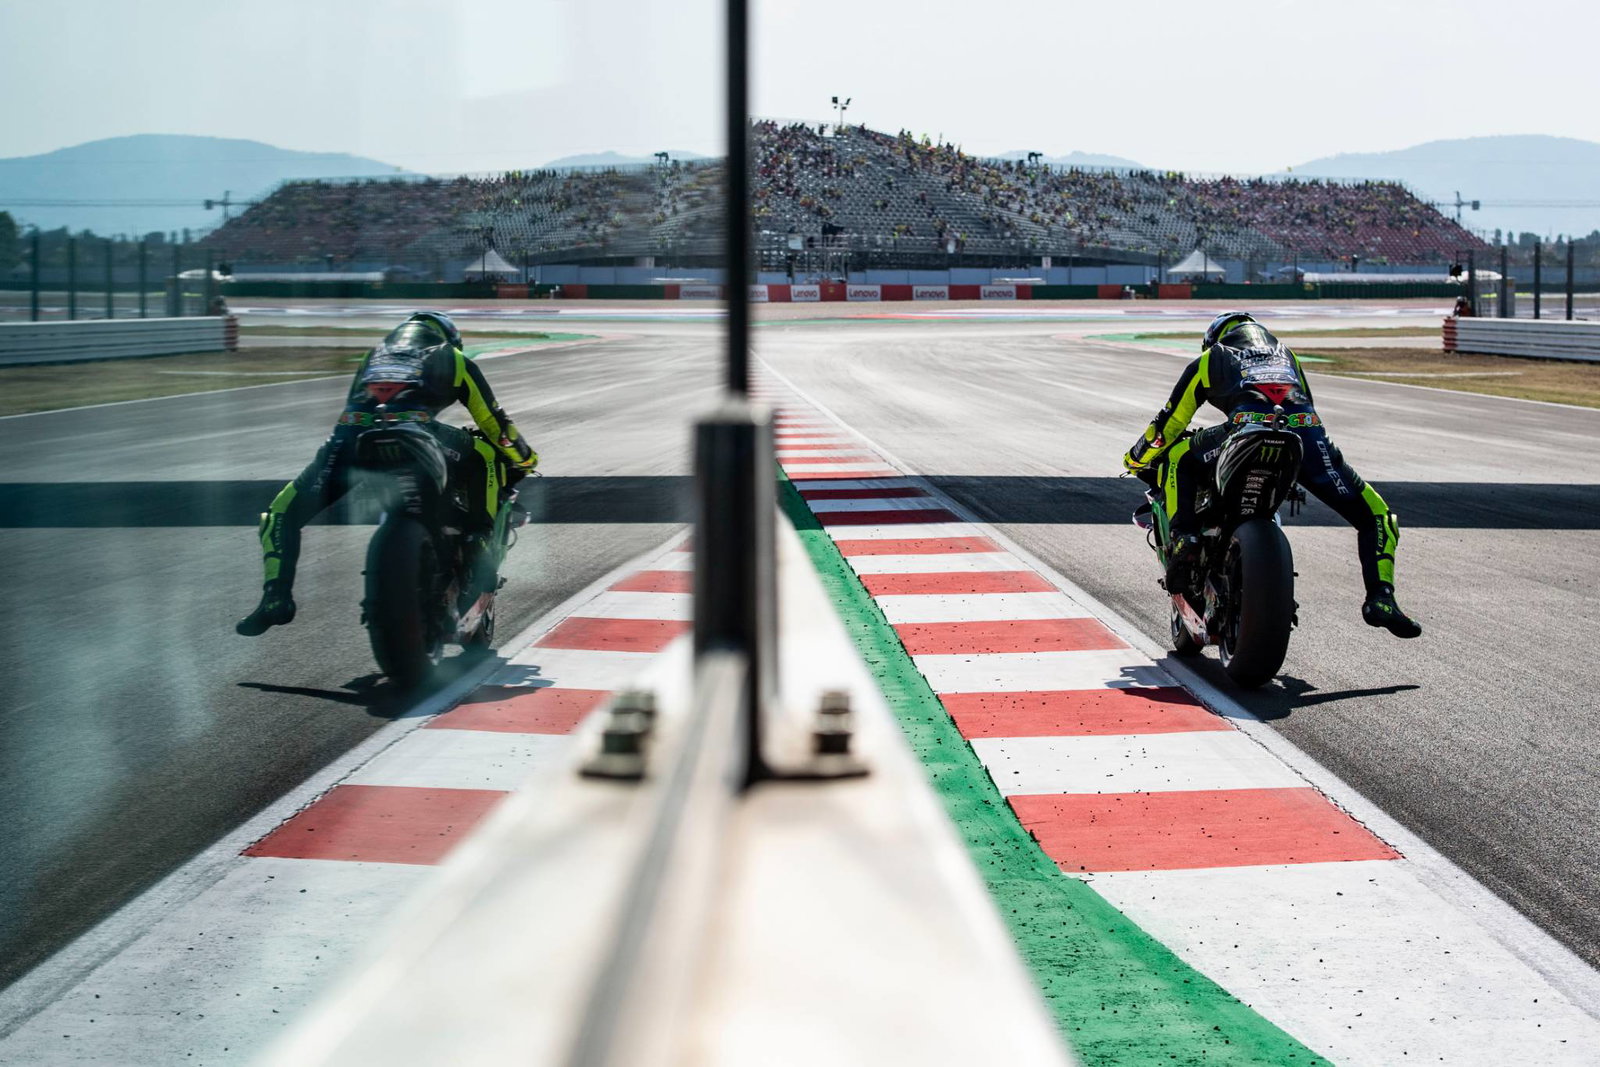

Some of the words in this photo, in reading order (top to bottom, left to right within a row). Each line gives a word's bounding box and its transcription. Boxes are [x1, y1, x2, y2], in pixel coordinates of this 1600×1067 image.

[793, 289, 818, 298] Lenovo
[849, 288, 879, 298] Lenovo
[915, 288, 946, 299] Lenovo
[983, 288, 1013, 298] Lenovo
[1265, 412, 1321, 428] DCTOR
